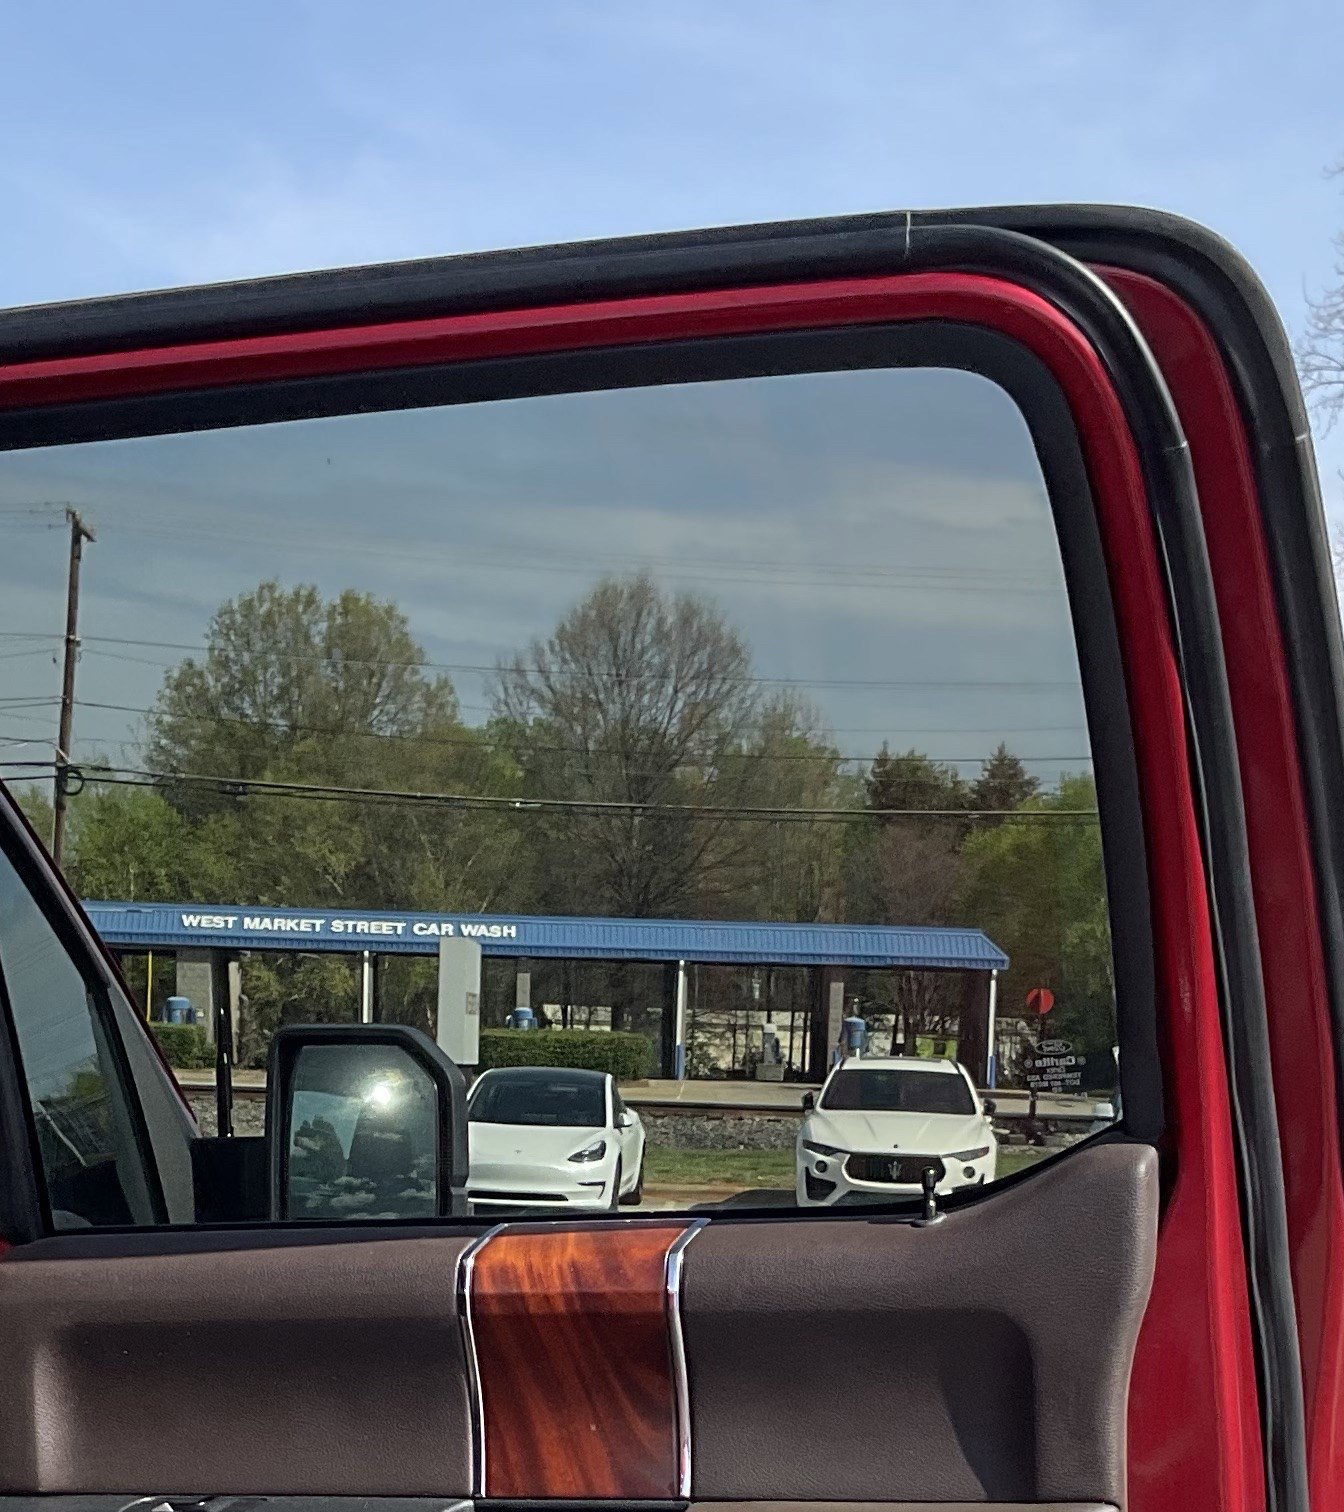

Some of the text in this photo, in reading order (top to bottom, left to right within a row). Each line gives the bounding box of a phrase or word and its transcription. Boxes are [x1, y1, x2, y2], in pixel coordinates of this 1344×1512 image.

[181, 914, 517, 938] WEST MARKET STREET CAR WASH
